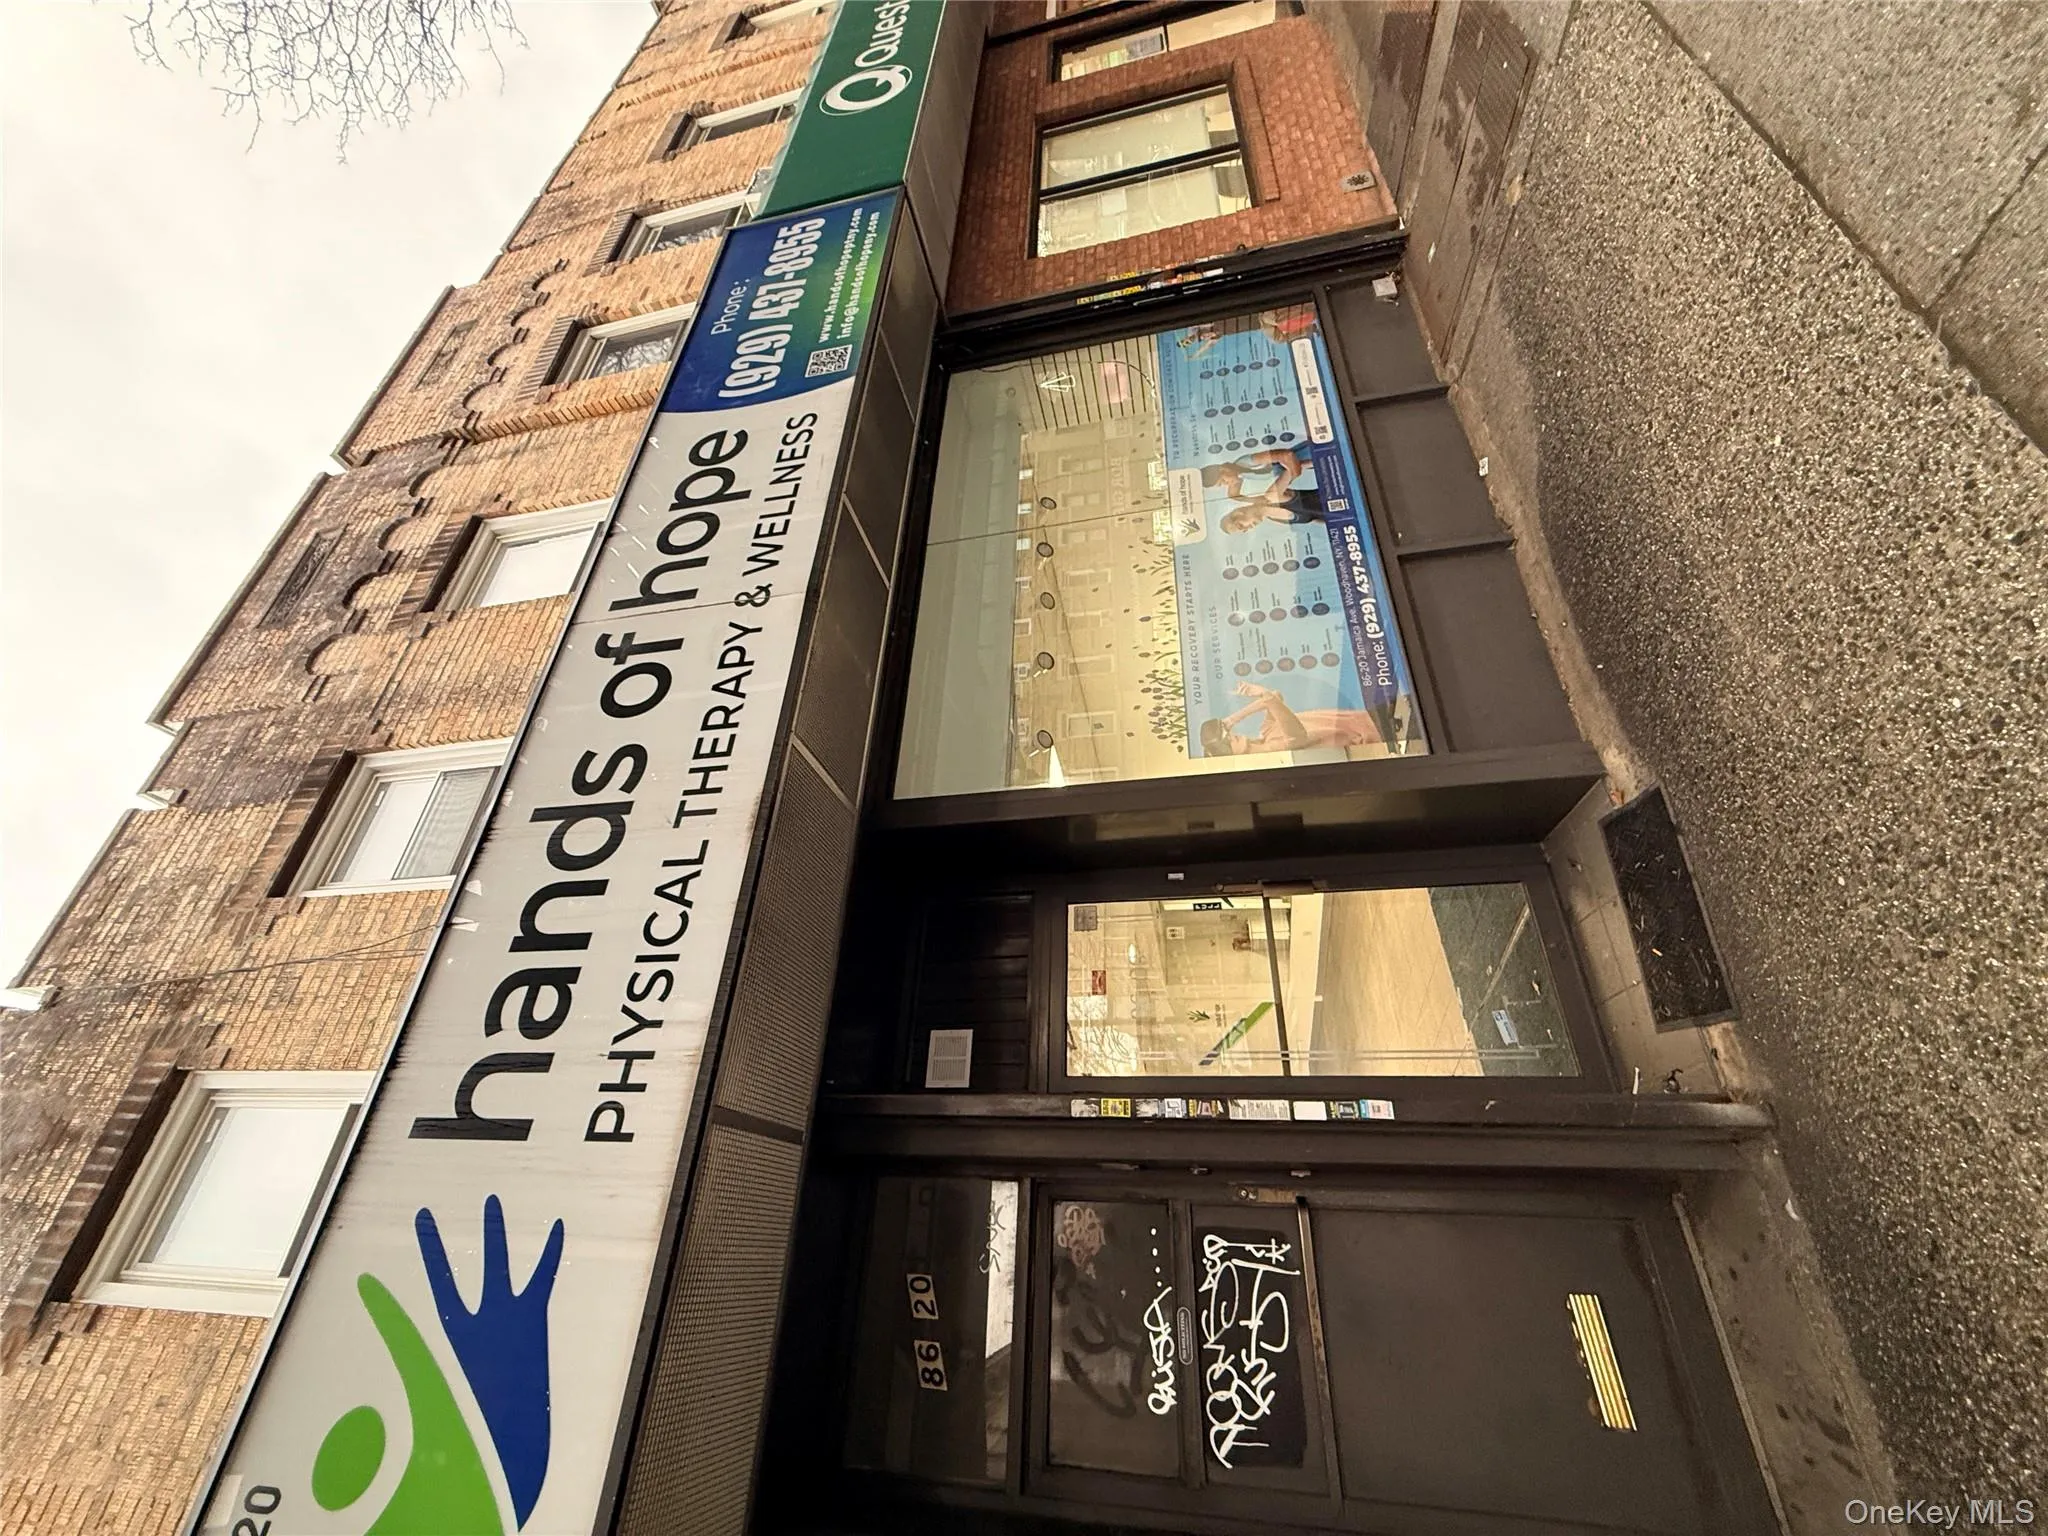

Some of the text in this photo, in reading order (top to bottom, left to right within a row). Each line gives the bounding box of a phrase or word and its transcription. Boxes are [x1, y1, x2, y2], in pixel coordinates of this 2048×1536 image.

[854, 0, 911, 67] Quest
[711, 278, 751, 336] Phone:
[718, 217, 826, 398] (929) 437-8955
[1182, 554, 1203, 705] YOUR RECOVERY STARTS HERE
[1208, 605, 1224, 681] OUR SERVICES
[1343, 525, 1393, 687] Phone: (929) 437-8955
[1354, 625, 1367, 659] Jamaica
[1358, 660, 1372, 687] 86-20
[408, 428, 750, 1142] hands of hope
[585, 412, 819, 1143] PHYSICAL THERAPY & WELLNESS
[909, 1275, 945, 1387] 86 20
